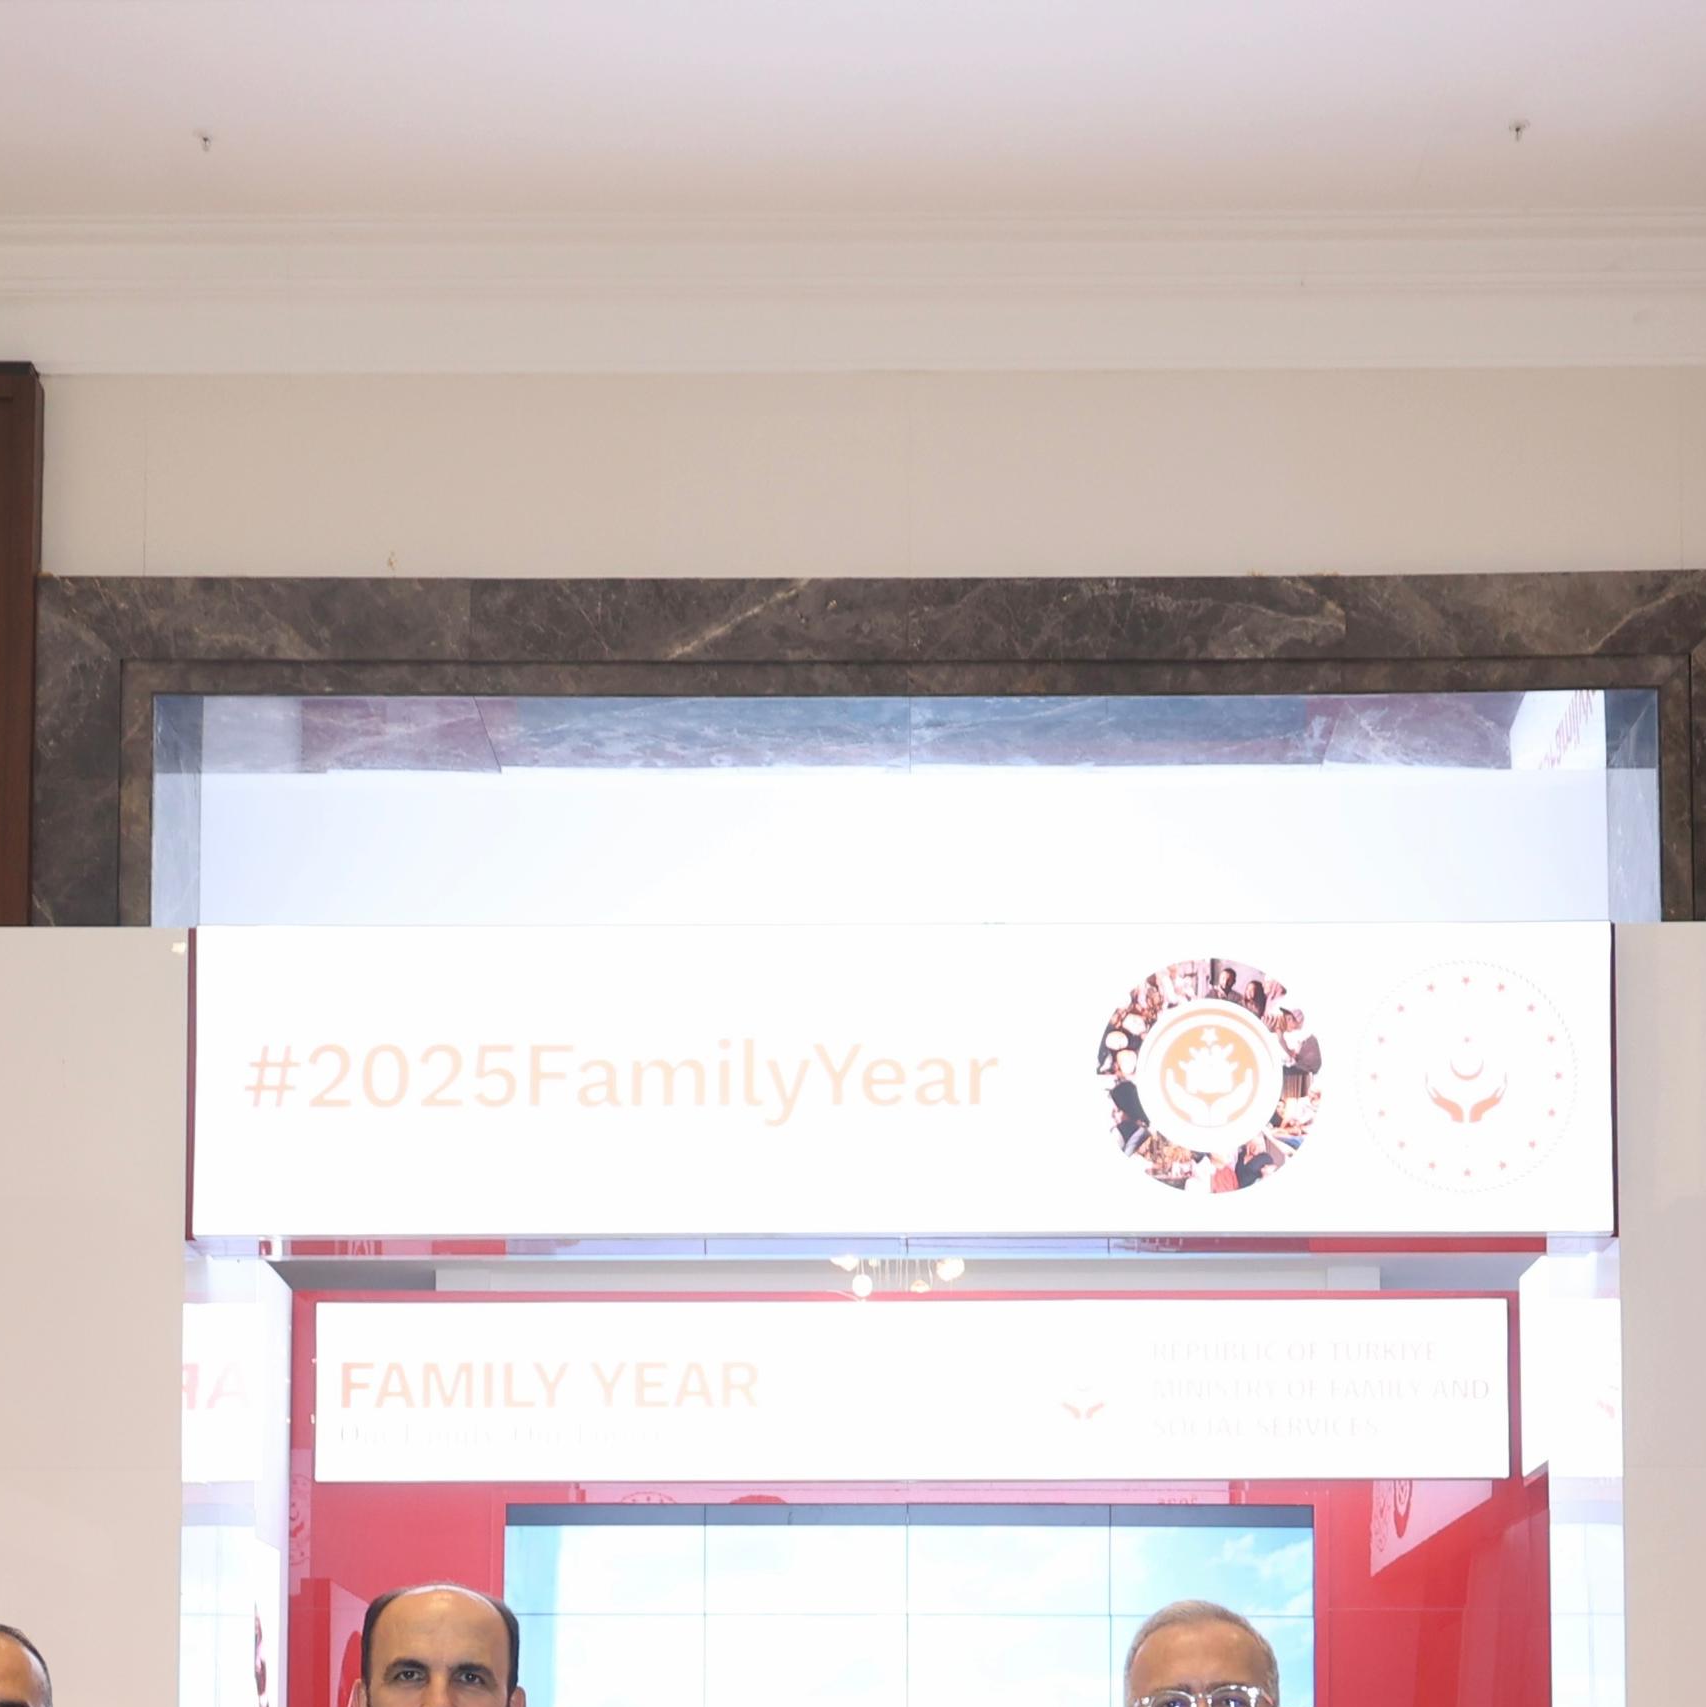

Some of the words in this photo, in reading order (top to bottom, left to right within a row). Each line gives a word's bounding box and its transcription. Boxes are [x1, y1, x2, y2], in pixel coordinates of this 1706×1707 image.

[244, 1036, 1000, 1128] #2025FamilyYear
[340, 1361, 572, 1409] FAMILY
[589, 1361, 762, 1408] YEAR
